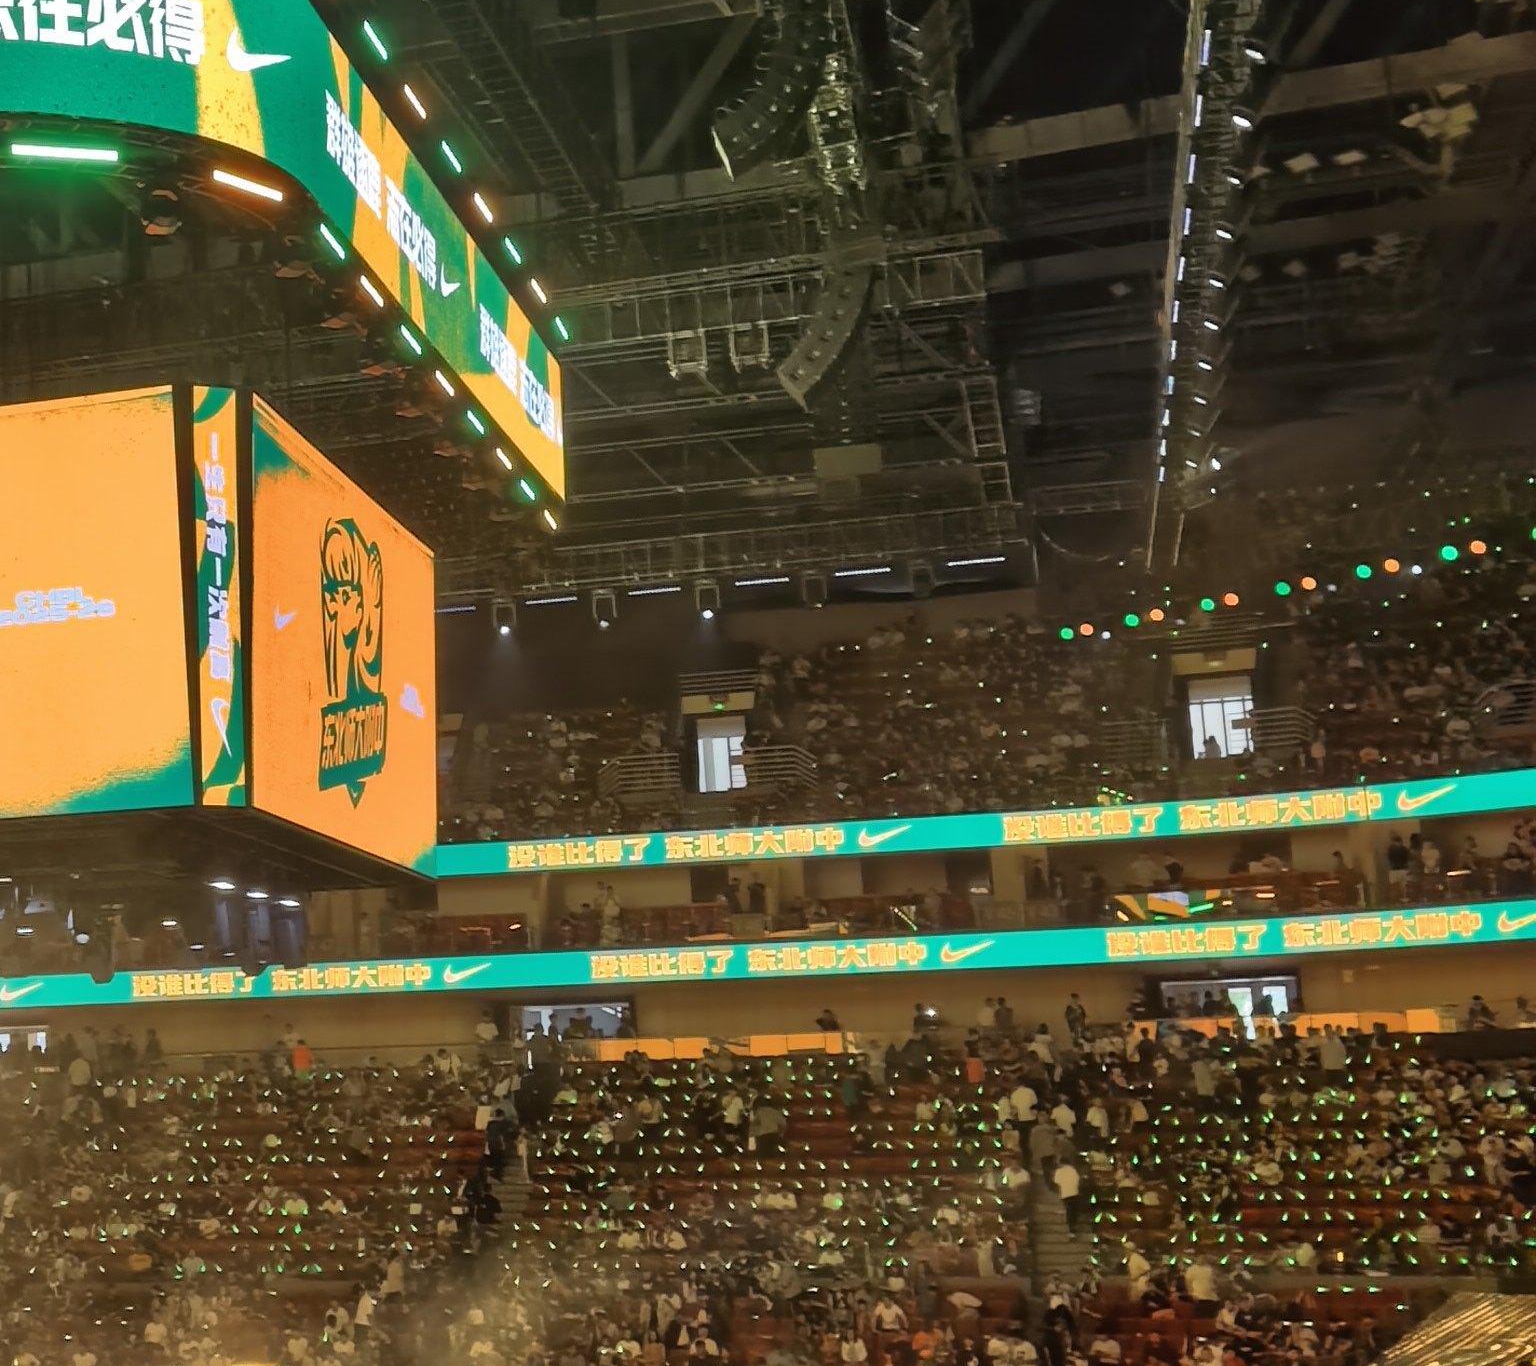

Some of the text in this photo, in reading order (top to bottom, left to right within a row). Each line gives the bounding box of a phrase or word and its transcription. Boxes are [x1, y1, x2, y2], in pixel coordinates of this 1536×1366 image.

[1179, 788, 1382, 832] 东北师大附中
[507, 827, 845, 869] 没谁比得了 东北师大附中
[1283, 911, 1482, 949] 东北师大附中
[271, 964, 431, 992] 东北师大附中
[591, 942, 927, 980] 没谁比得了 东北师大附中
